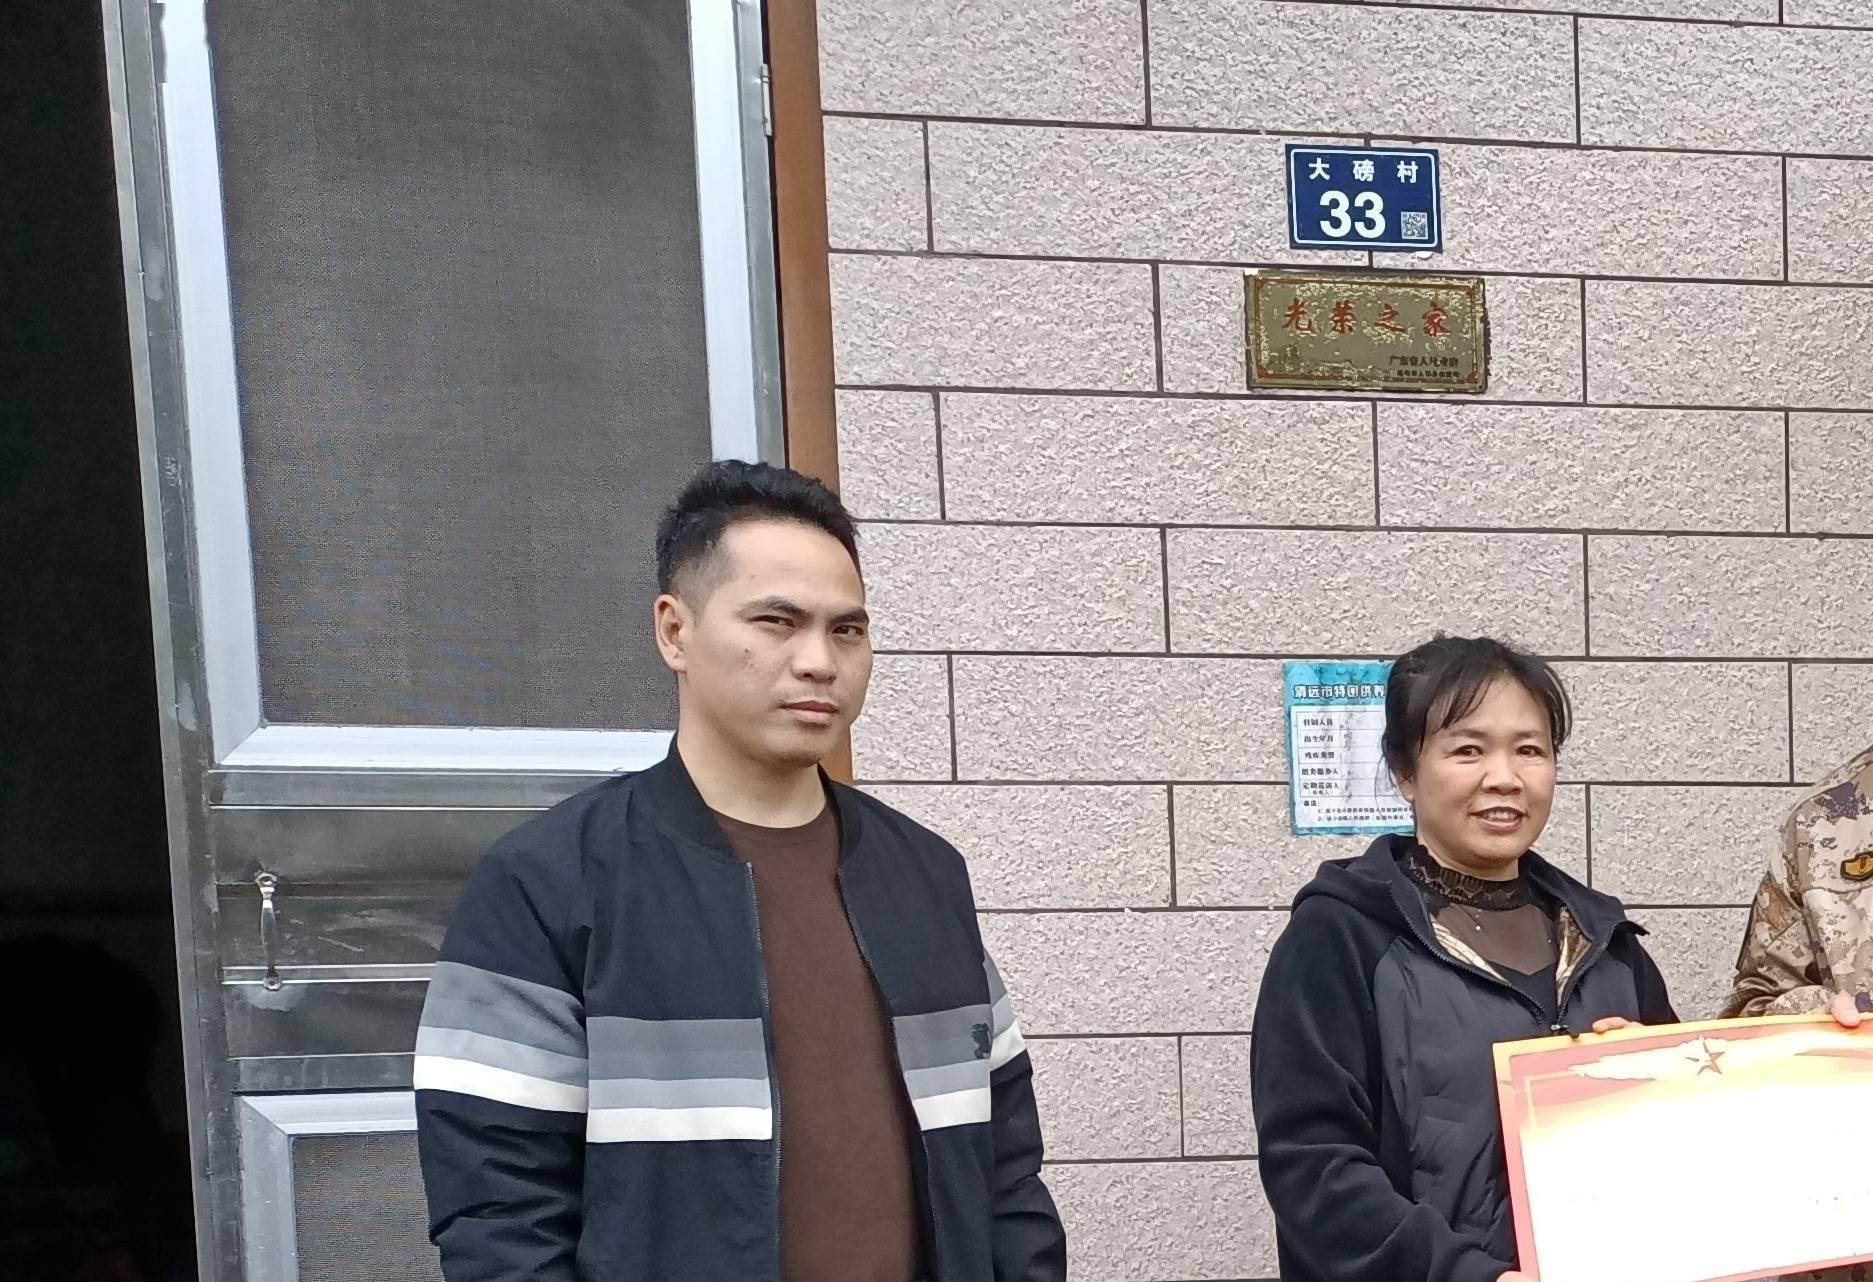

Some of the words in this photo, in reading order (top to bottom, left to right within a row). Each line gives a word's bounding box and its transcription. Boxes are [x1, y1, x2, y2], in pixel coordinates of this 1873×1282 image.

[1308, 157, 1419, 184] 大磅村
[1319, 190, 1387, 239] 33
[1281, 298, 1452, 337] 光荣之家
